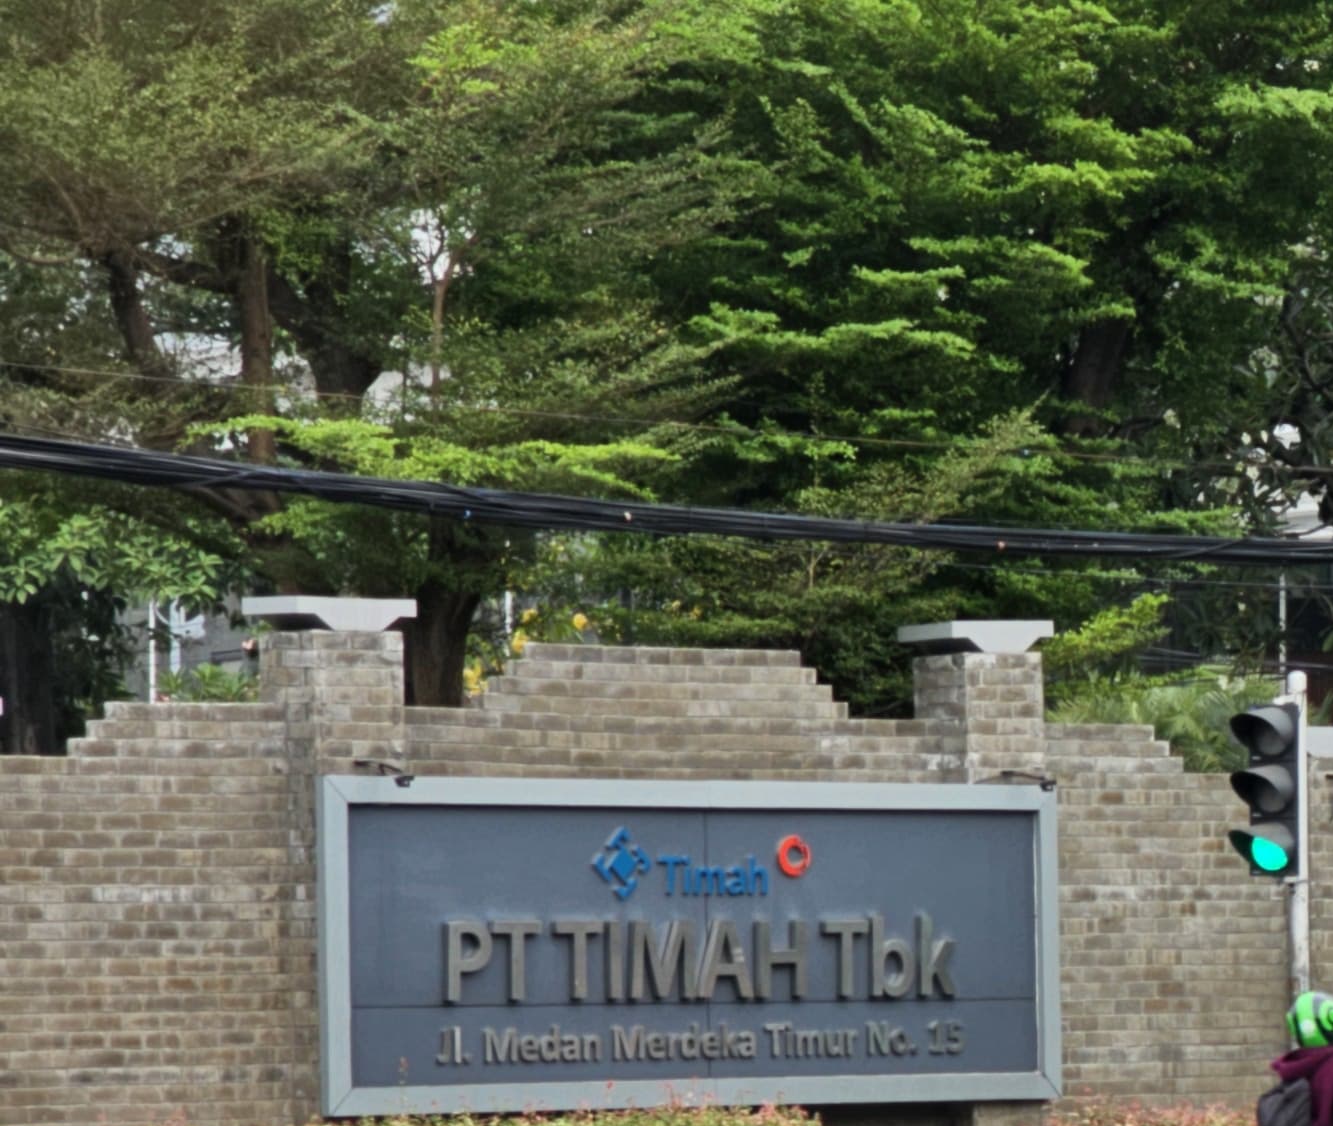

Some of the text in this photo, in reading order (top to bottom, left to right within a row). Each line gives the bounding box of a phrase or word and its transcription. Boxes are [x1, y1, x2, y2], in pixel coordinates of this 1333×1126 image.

[656, 854, 770, 897] Timah
[442, 912, 957, 1003] PT TIMAH Tbk
[437, 1019, 965, 1065] Jl. Medan Merdeka Timur No. 15
